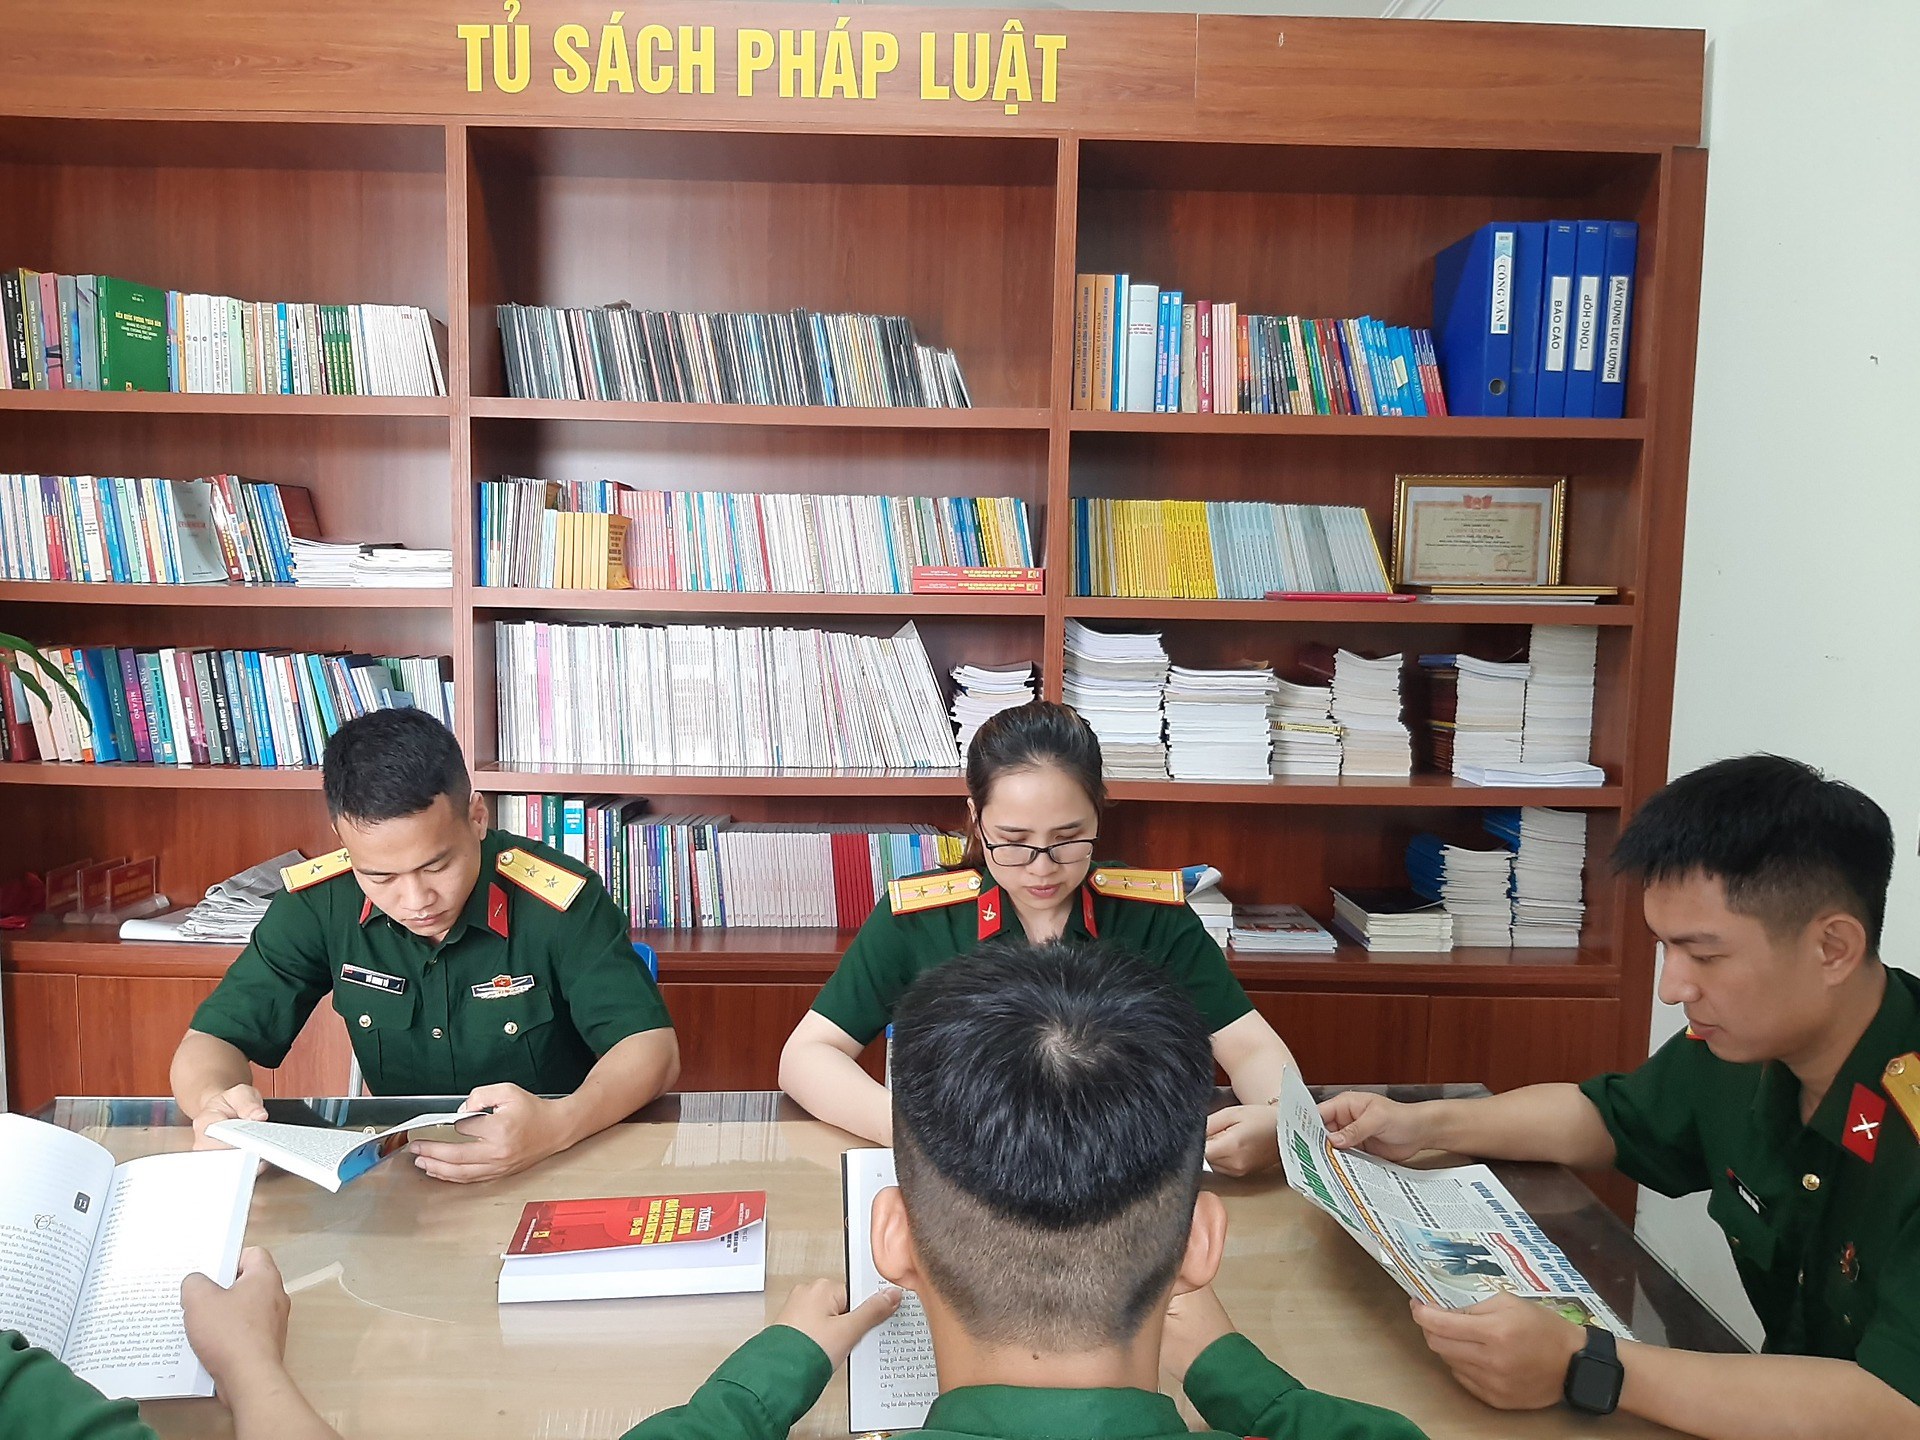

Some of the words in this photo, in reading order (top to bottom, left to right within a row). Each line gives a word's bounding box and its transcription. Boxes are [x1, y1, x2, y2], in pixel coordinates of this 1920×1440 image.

[457, 0, 530, 94] TỦ
[553, 11, 714, 94] SÁCH
[737, 17, 898, 99] PHÁP
[920, 19, 1066, 115] LUẬT
[1496, 264, 1508, 297] CÔNG
[1552, 300, 1564, 324] BÁO
[1583, 294, 1594, 318] HỢP
[1611, 300, 1622, 326] DỰNG
[1551, 326, 1562, 350] CÁO
[1608, 327, 1620, 346] LỰC
[1606, 348, 1618, 379] LƯỢNG
[78, 1199, 87, 1209] 13
